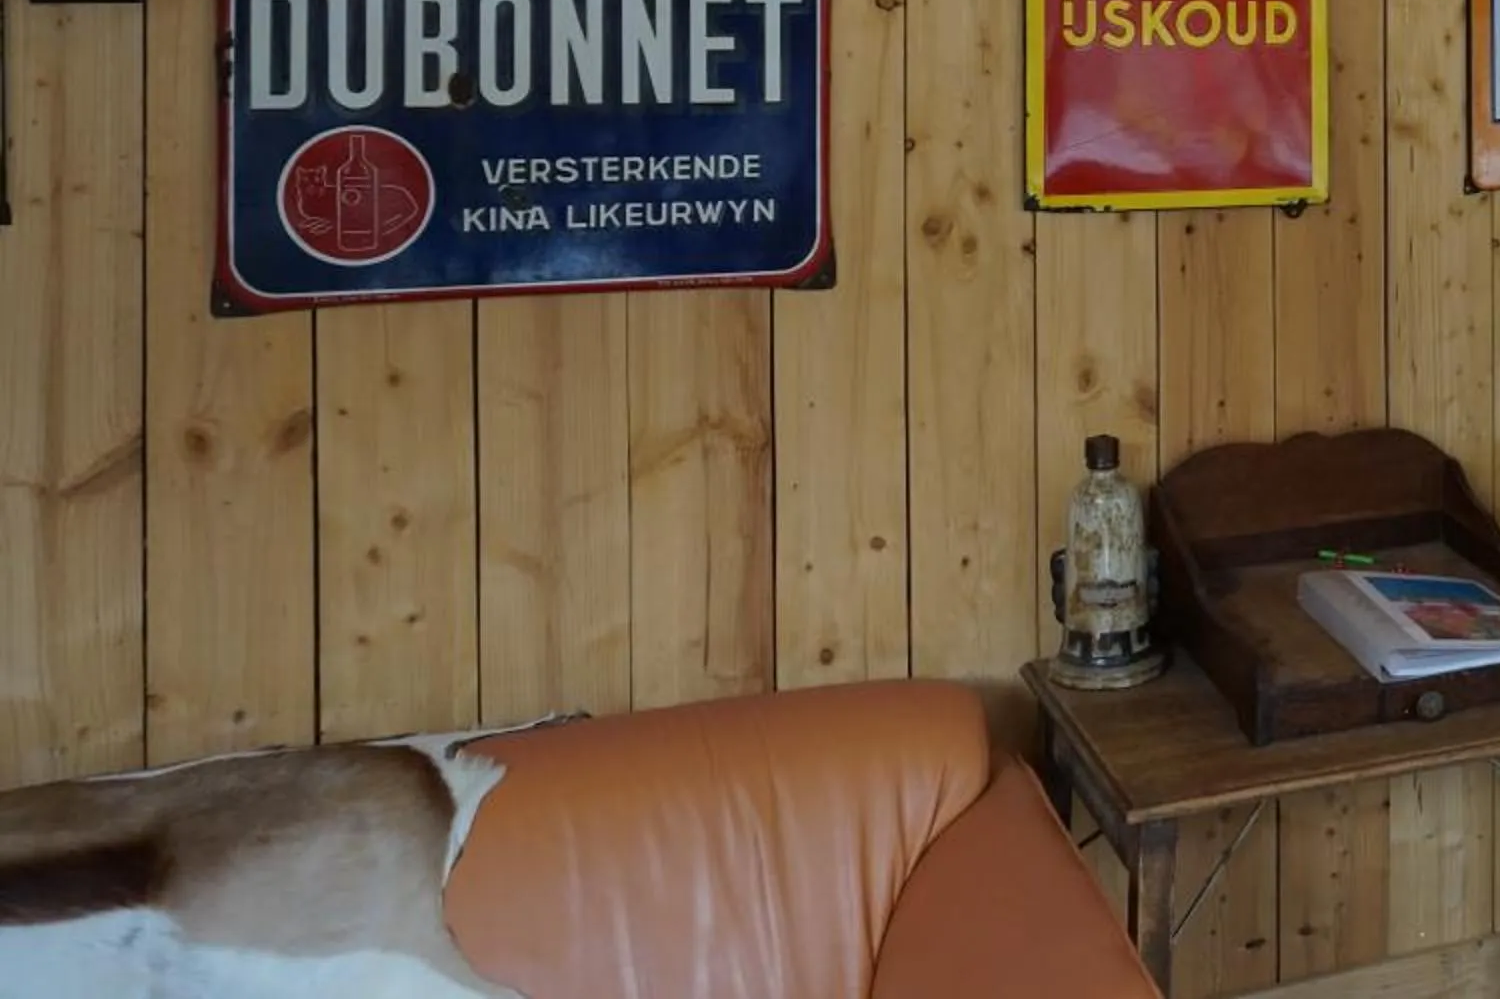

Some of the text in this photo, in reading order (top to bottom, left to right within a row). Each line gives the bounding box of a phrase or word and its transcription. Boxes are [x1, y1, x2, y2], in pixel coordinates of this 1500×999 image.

[480, 154, 762, 185] VERSTERKENDE
[461, 198, 777, 233] KINA LIKEURWYN
